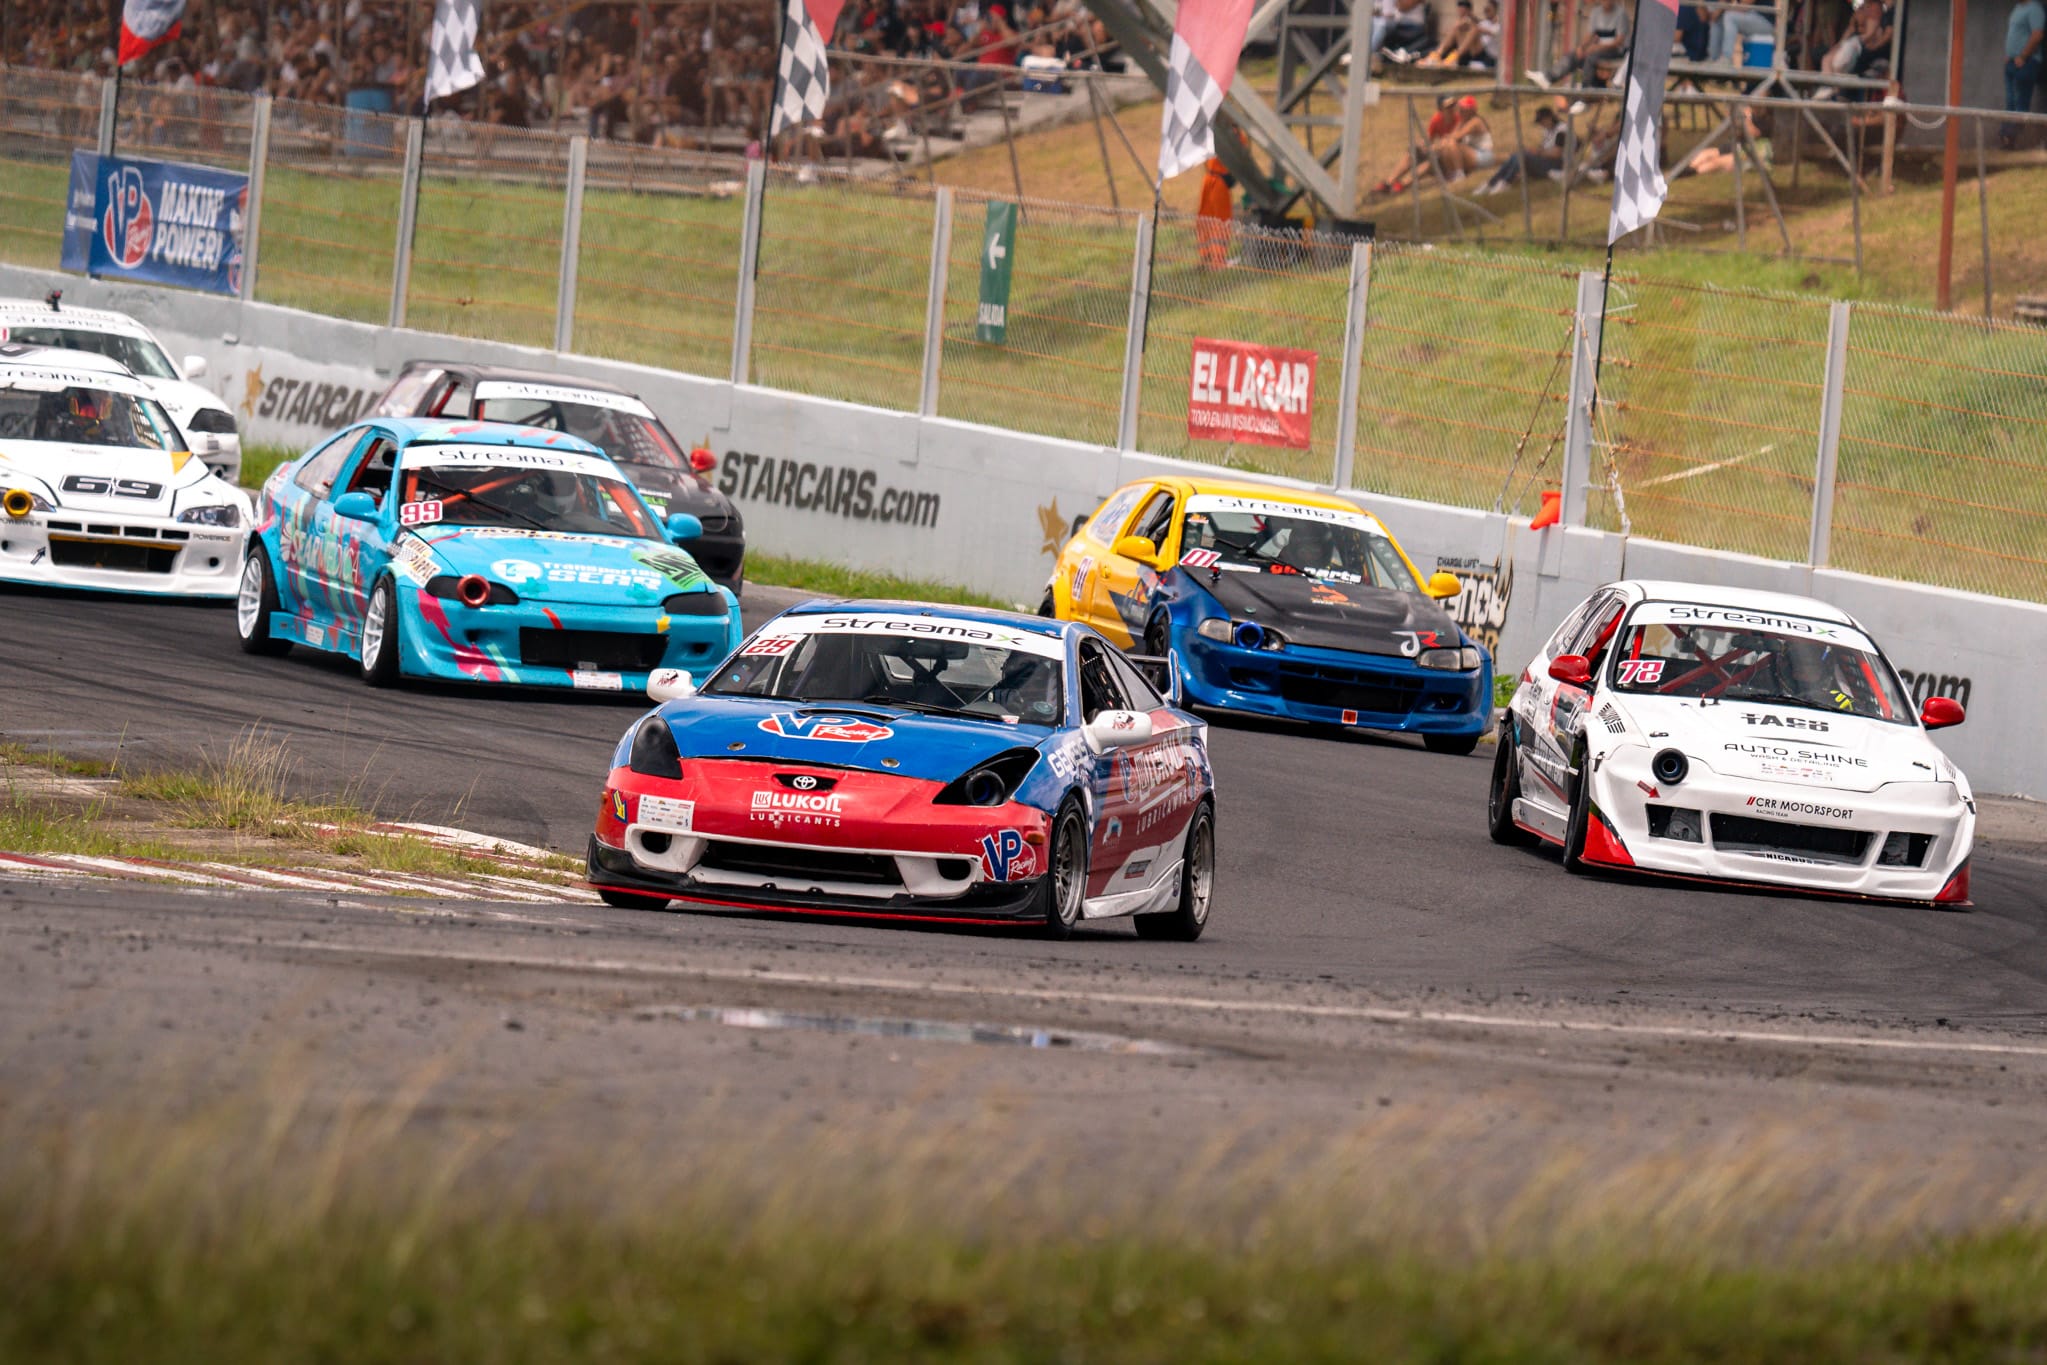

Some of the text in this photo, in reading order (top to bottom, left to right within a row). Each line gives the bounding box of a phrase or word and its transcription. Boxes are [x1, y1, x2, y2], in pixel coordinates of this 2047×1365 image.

[152, 223, 224, 271] POWER!
[1192, 351, 1310, 414] EL LAGAR
[60, 475, 166, 500] 69
[718, 450, 941, 529] STARCARS.com
[402, 501, 441, 525] 99
[745, 639, 797, 654] 29
[1617, 660, 1665, 684] 72
[1724, 743, 1869, 768] AUTO SHINE
[772, 793, 842, 813] LUKOIL
[1756, 797, 1854, 820] CRR MOTORSPORT
[750, 813, 841, 828] LUBRICANTS
[981, 829, 1023, 882] VP
